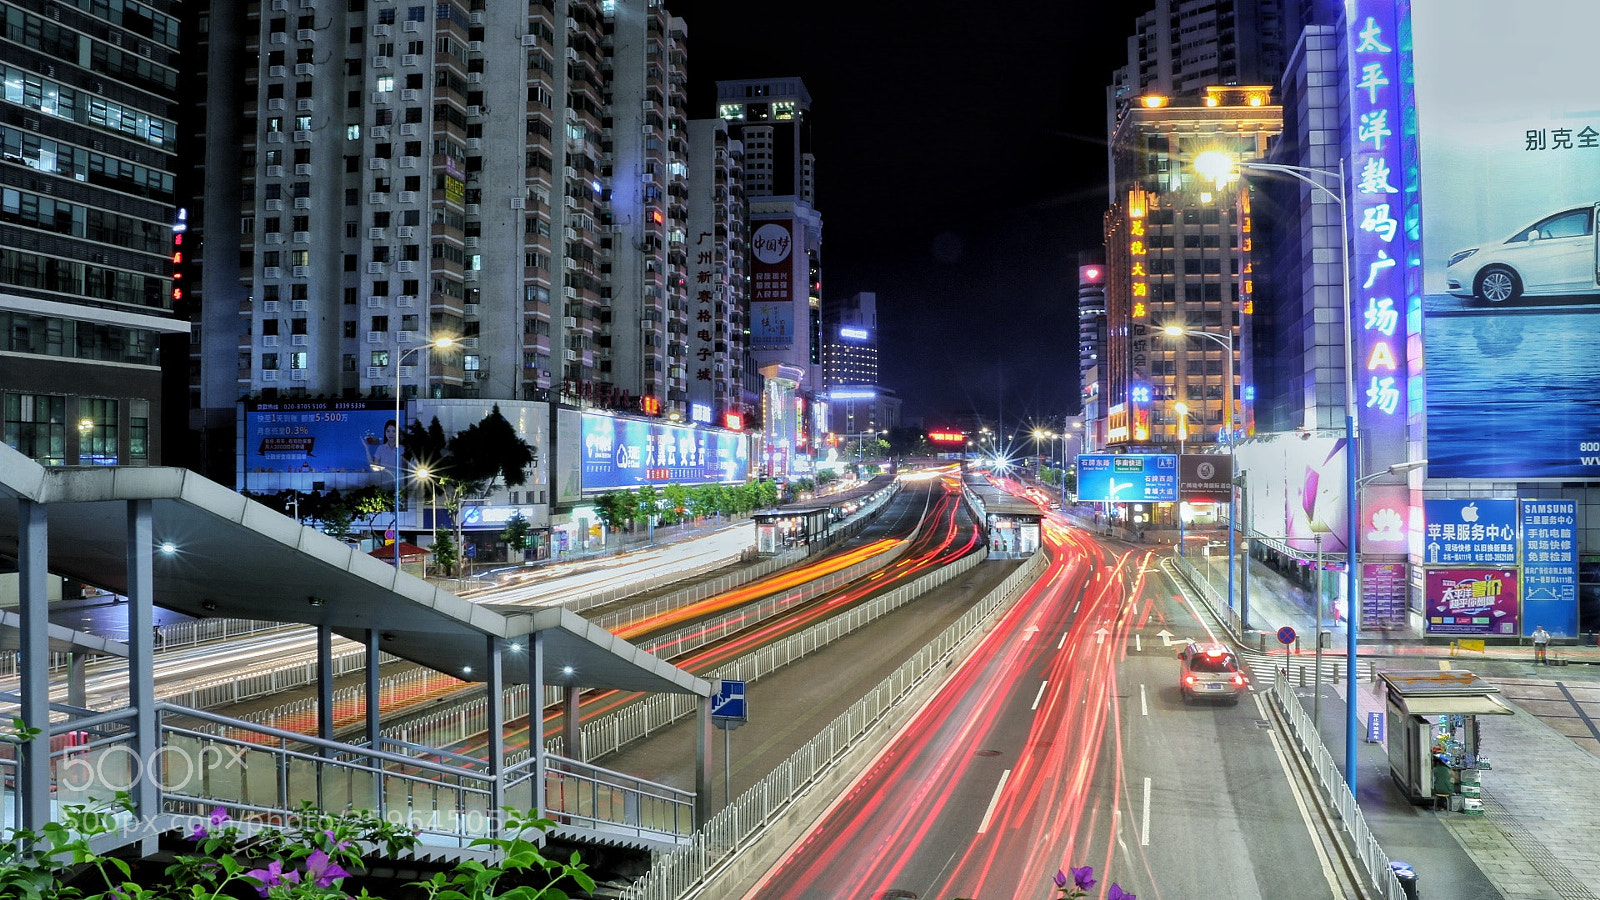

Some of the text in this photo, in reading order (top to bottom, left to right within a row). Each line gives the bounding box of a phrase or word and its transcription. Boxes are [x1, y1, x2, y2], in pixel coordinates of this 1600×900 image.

[1355, 17, 1400, 415] 太平洋数码广场A场
[754, 234, 790, 257] 中国梦
[1130, 220, 1147, 318] 总统大酒店
[696, 231, 713, 382] 广州新赛格电子城
[1524, 504, 1573, 514] SAMSUNG
[1525, 516, 1573, 525] 三星服务中心
[1428, 523, 1514, 541] 苹果服务中心
[1528, 529, 1571, 538] 手机电脑
[1444, 543, 1514, 552] 现场快修 以旧换新服务
[1528, 540, 1571, 550] 现场快修
[1528, 552, 1571, 561] 免费检测
